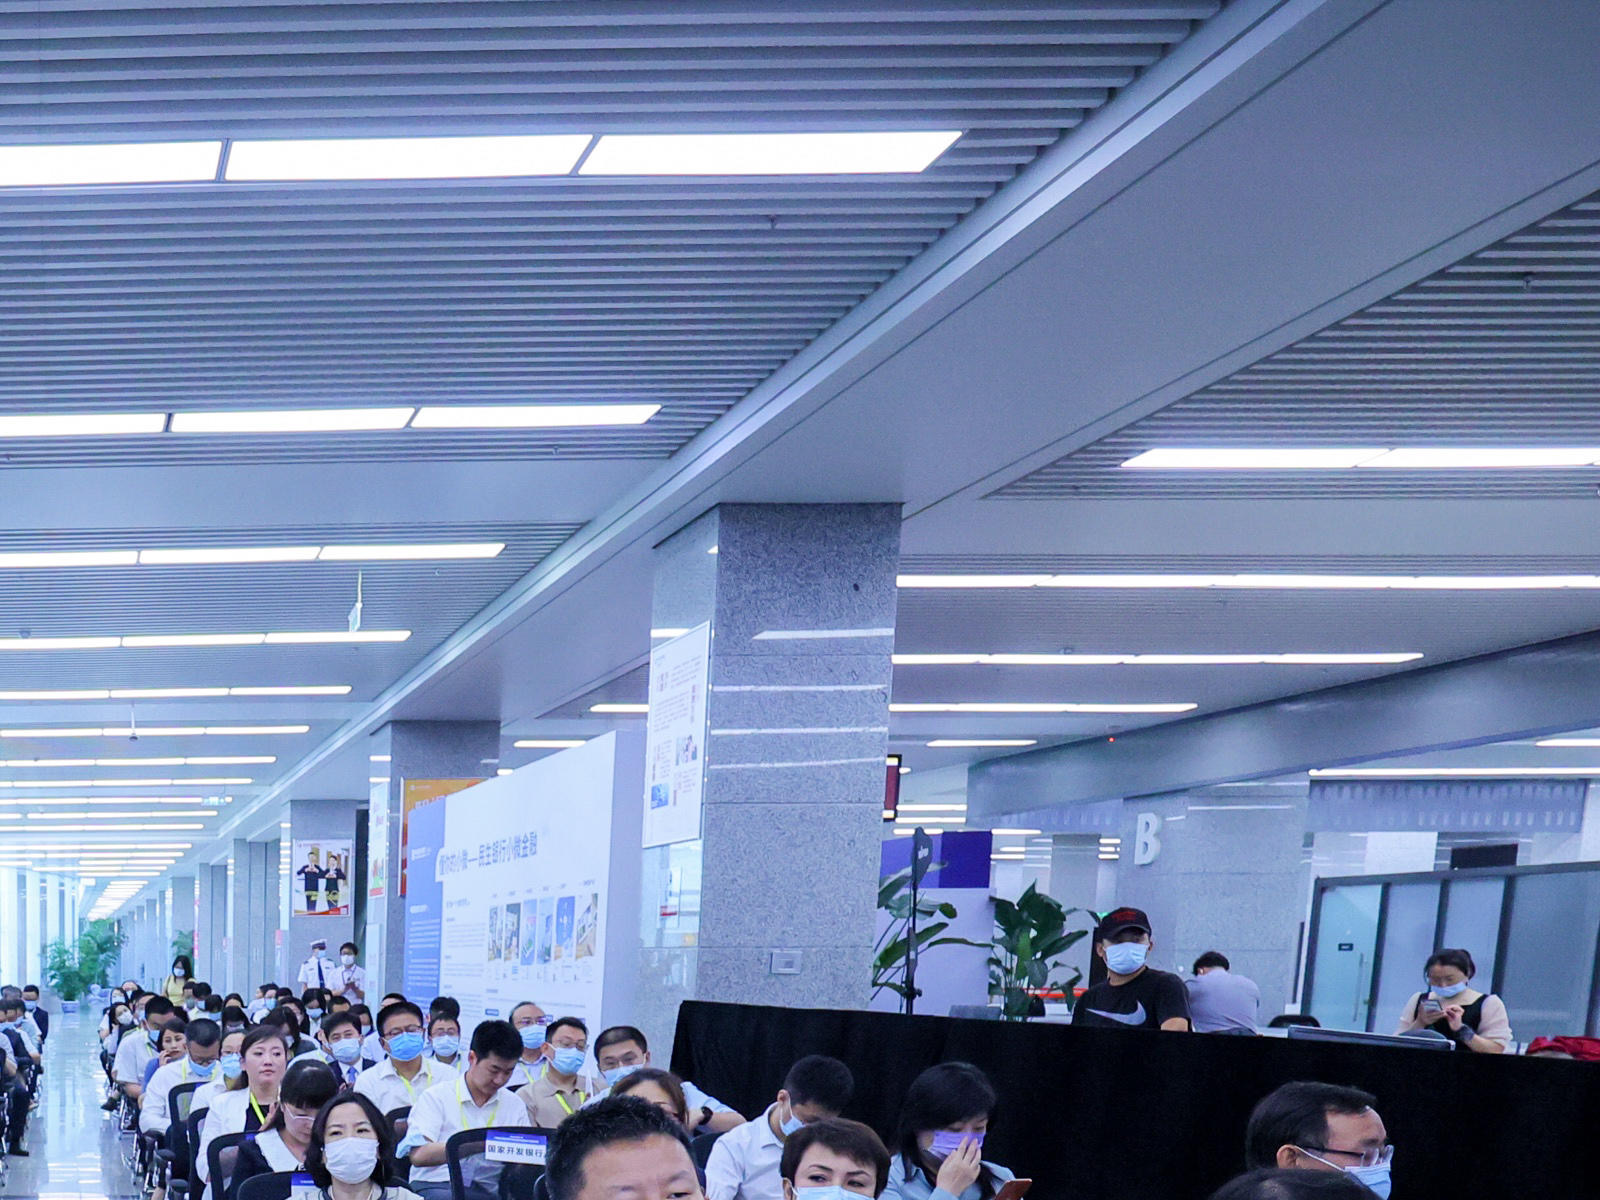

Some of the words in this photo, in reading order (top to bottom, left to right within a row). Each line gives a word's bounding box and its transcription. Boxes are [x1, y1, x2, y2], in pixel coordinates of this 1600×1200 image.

[1134, 812, 1161, 865] B
[487, 1144, 543, 1157] 国家开发银行
